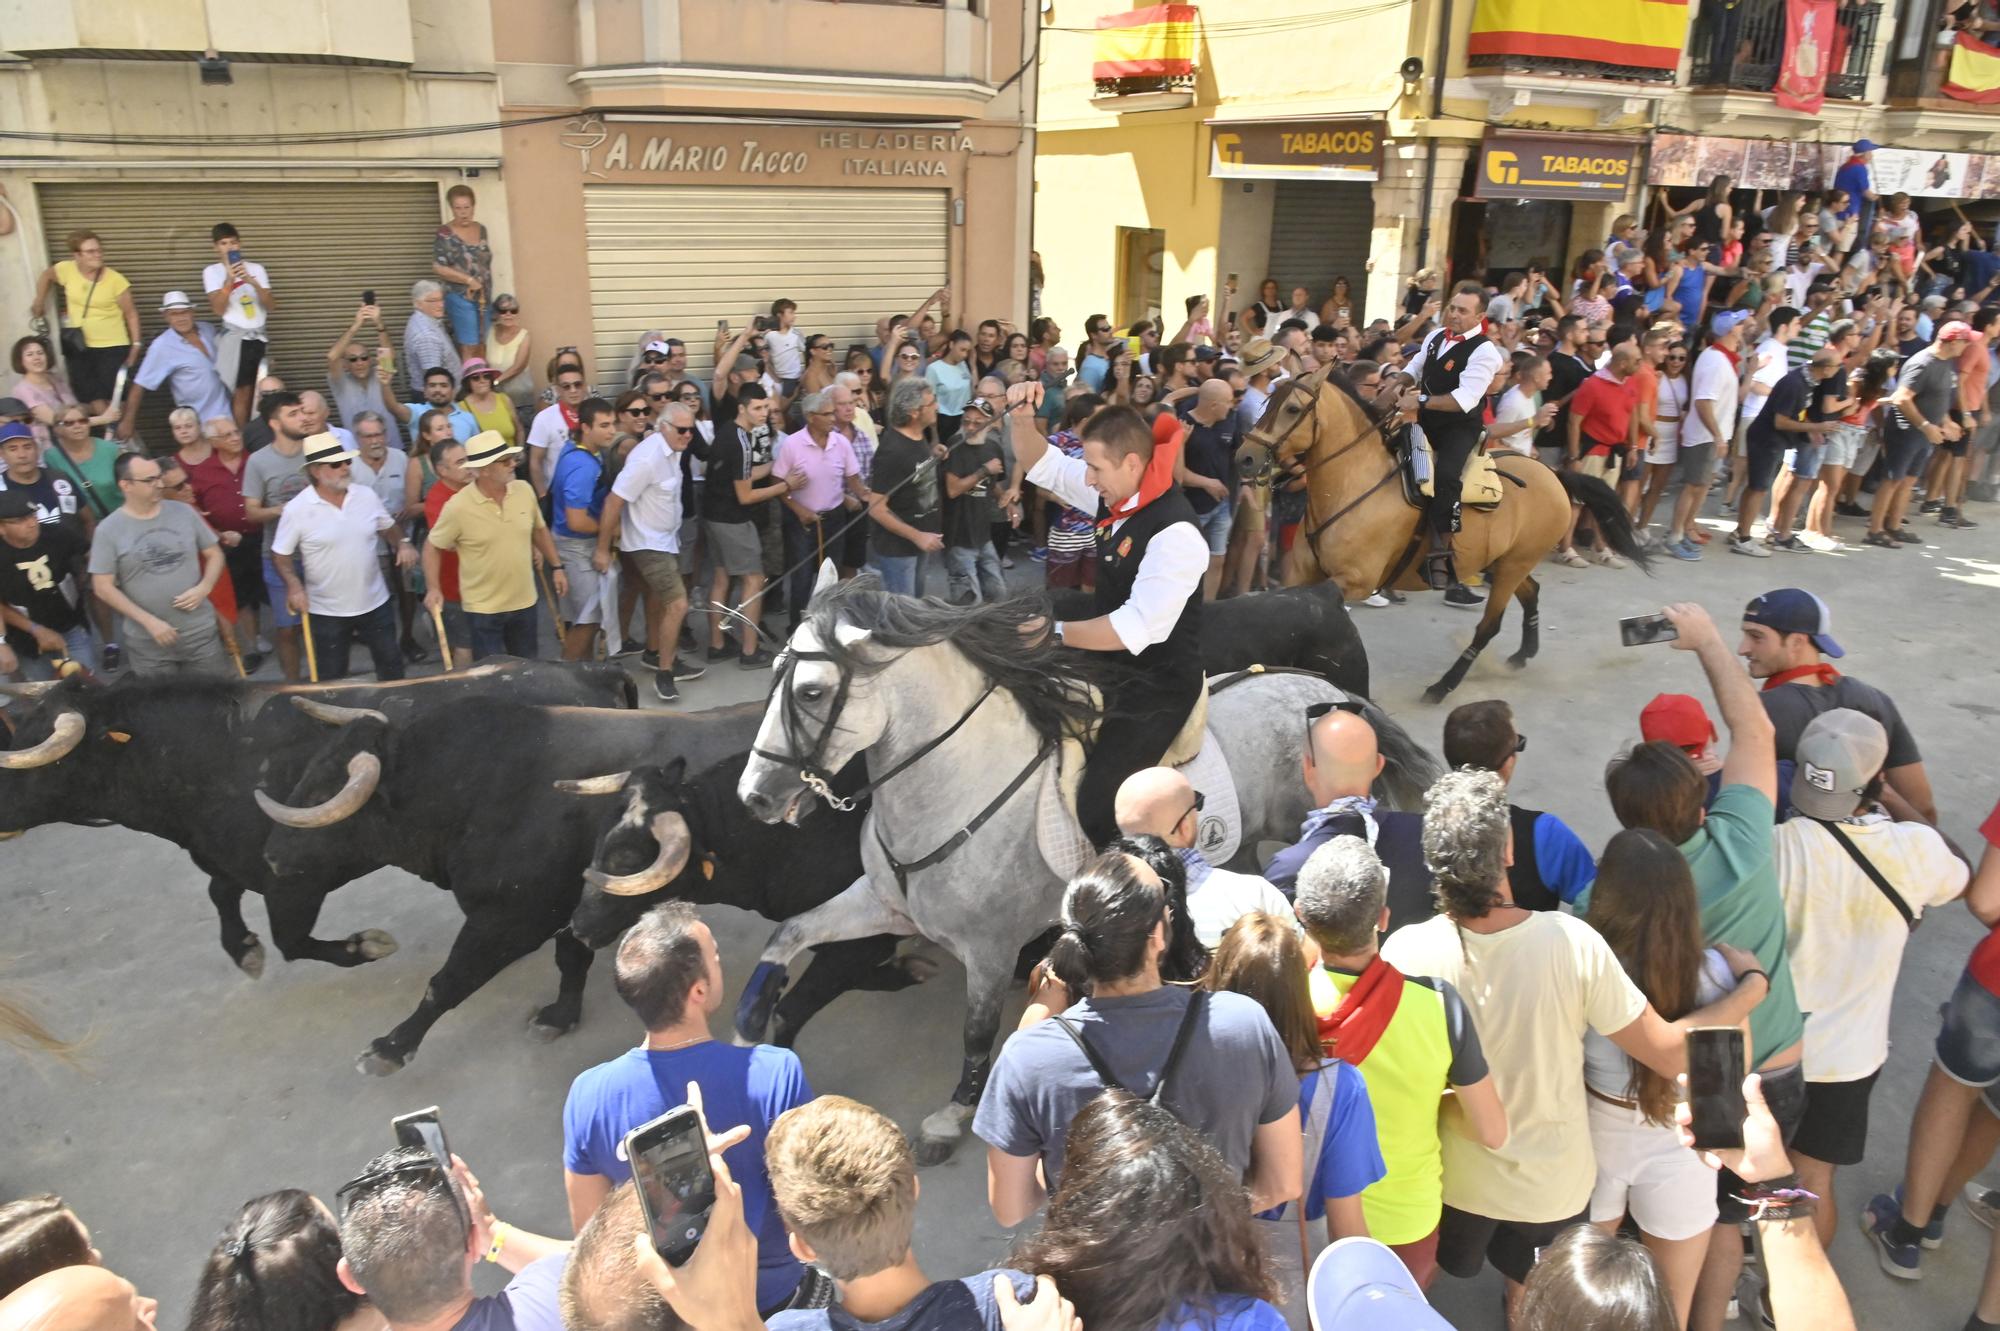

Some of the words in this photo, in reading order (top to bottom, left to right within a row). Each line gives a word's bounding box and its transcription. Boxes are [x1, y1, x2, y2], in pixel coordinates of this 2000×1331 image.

[819, 132, 974, 151] HELADERIA
[1280, 130, 1374, 154] TABACOS
[604, 132, 634, 170] A.
[640, 136, 728, 172] MARIO
[739, 141, 808, 173] TACCO
[844, 159, 948, 176] ITALIANA
[1541, 155, 1629, 176] TABACOS
